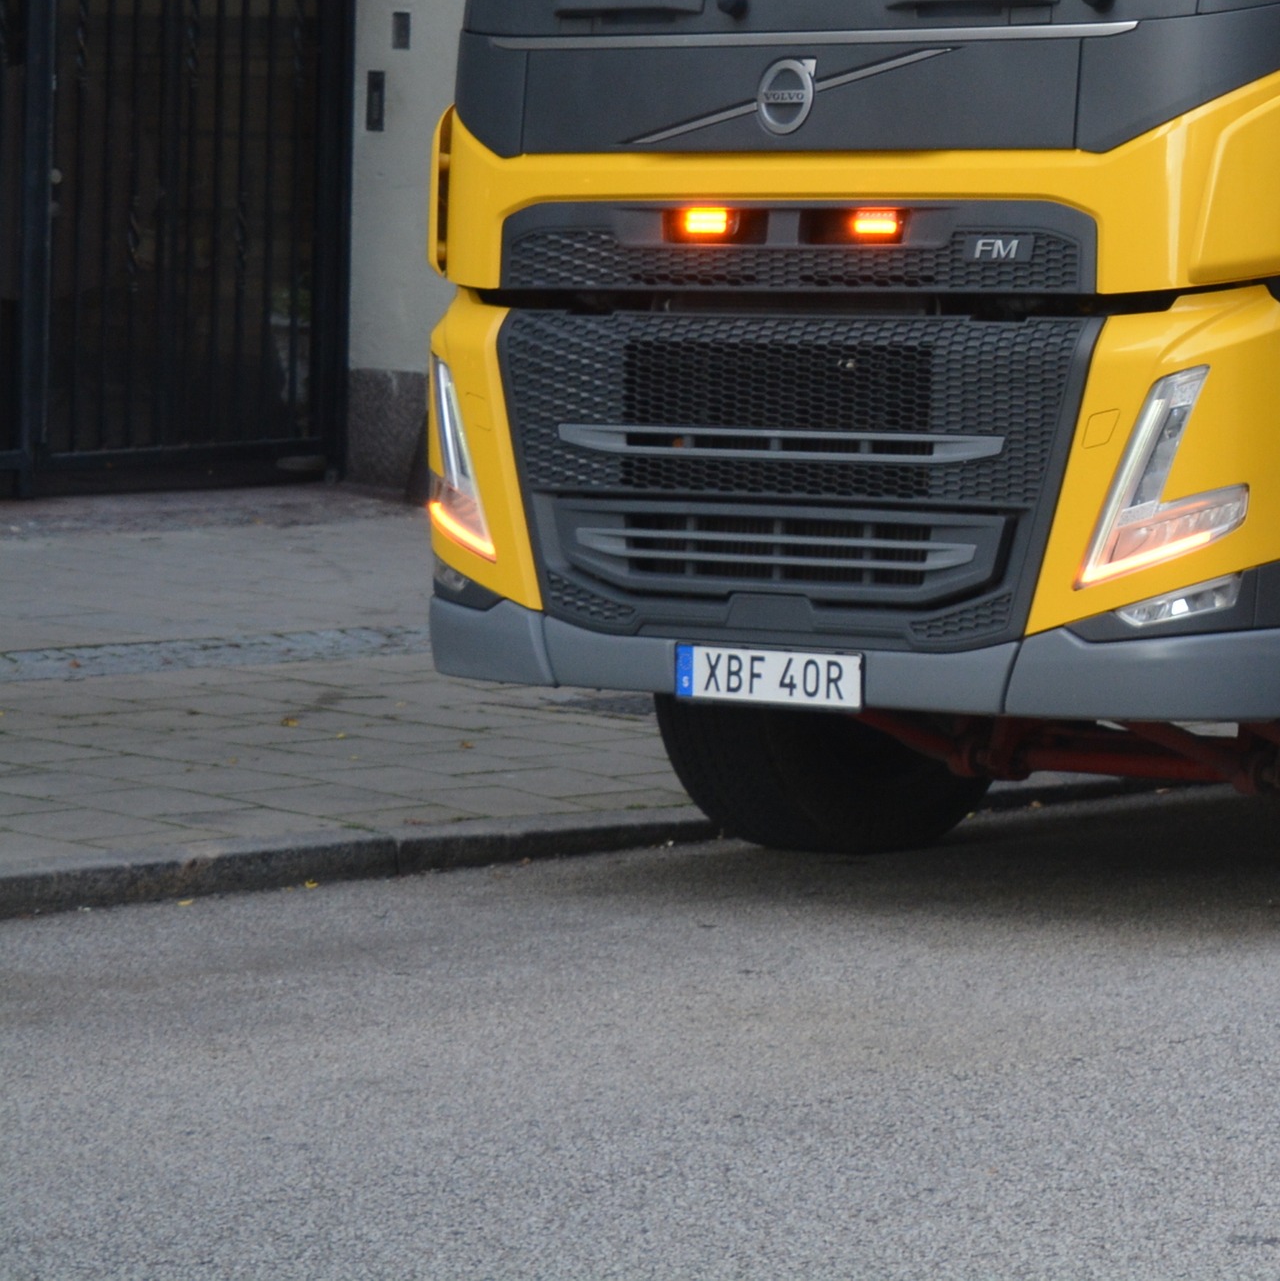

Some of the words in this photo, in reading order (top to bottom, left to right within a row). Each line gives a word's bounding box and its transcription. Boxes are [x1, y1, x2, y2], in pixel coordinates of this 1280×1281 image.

[763, 92, 804, 101] VOLVO
[974, 239, 1019, 259] FM
[682, 676, 690, 687] S
[704, 652, 765, 694] XBF
[779, 658, 843, 700] 40R
